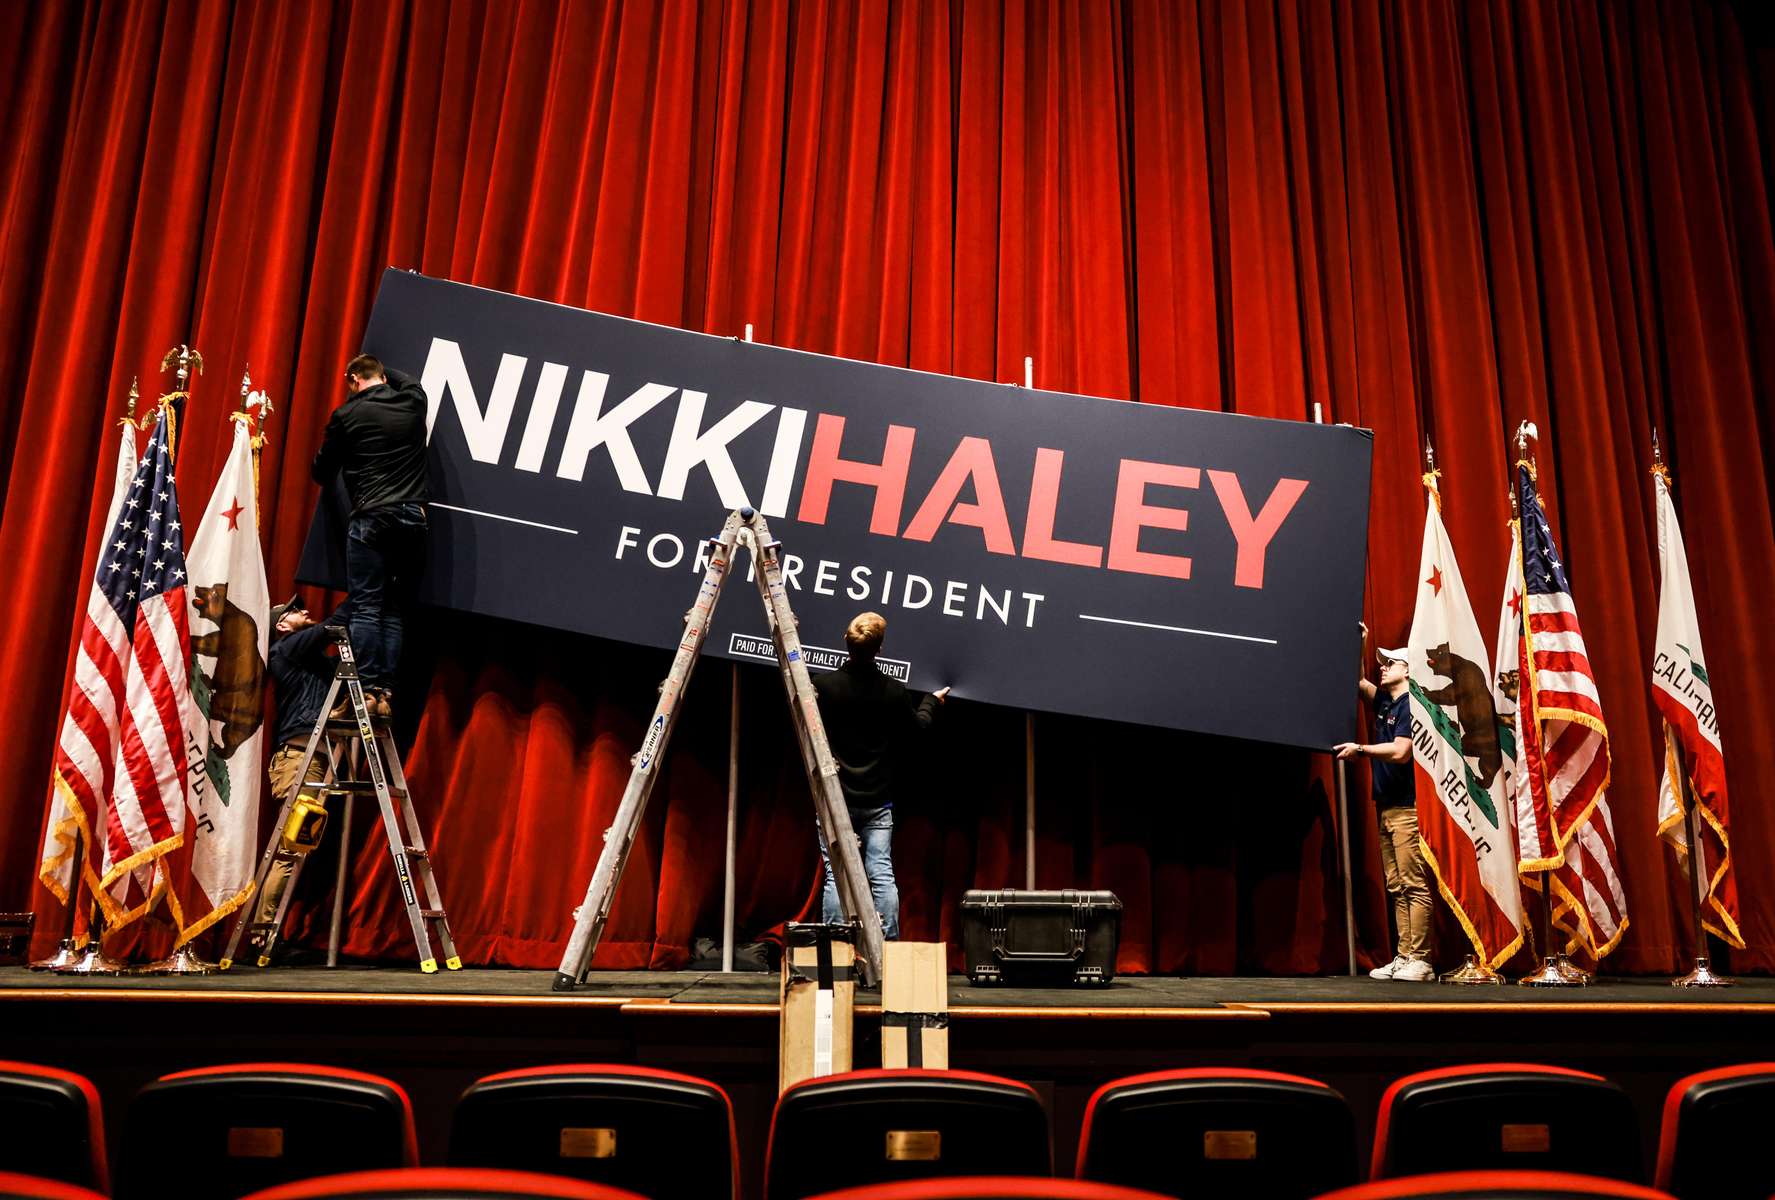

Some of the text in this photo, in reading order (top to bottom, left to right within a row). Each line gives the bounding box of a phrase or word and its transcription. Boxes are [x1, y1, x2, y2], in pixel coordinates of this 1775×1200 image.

[420, 336, 1310, 589] NIKKI HALEY
[746, 553, 1046, 628] RESIDENT
[736, 639, 756, 653] PAID
[757, 642, 775, 656] FOR
[813, 651, 840, 667] HALEY
